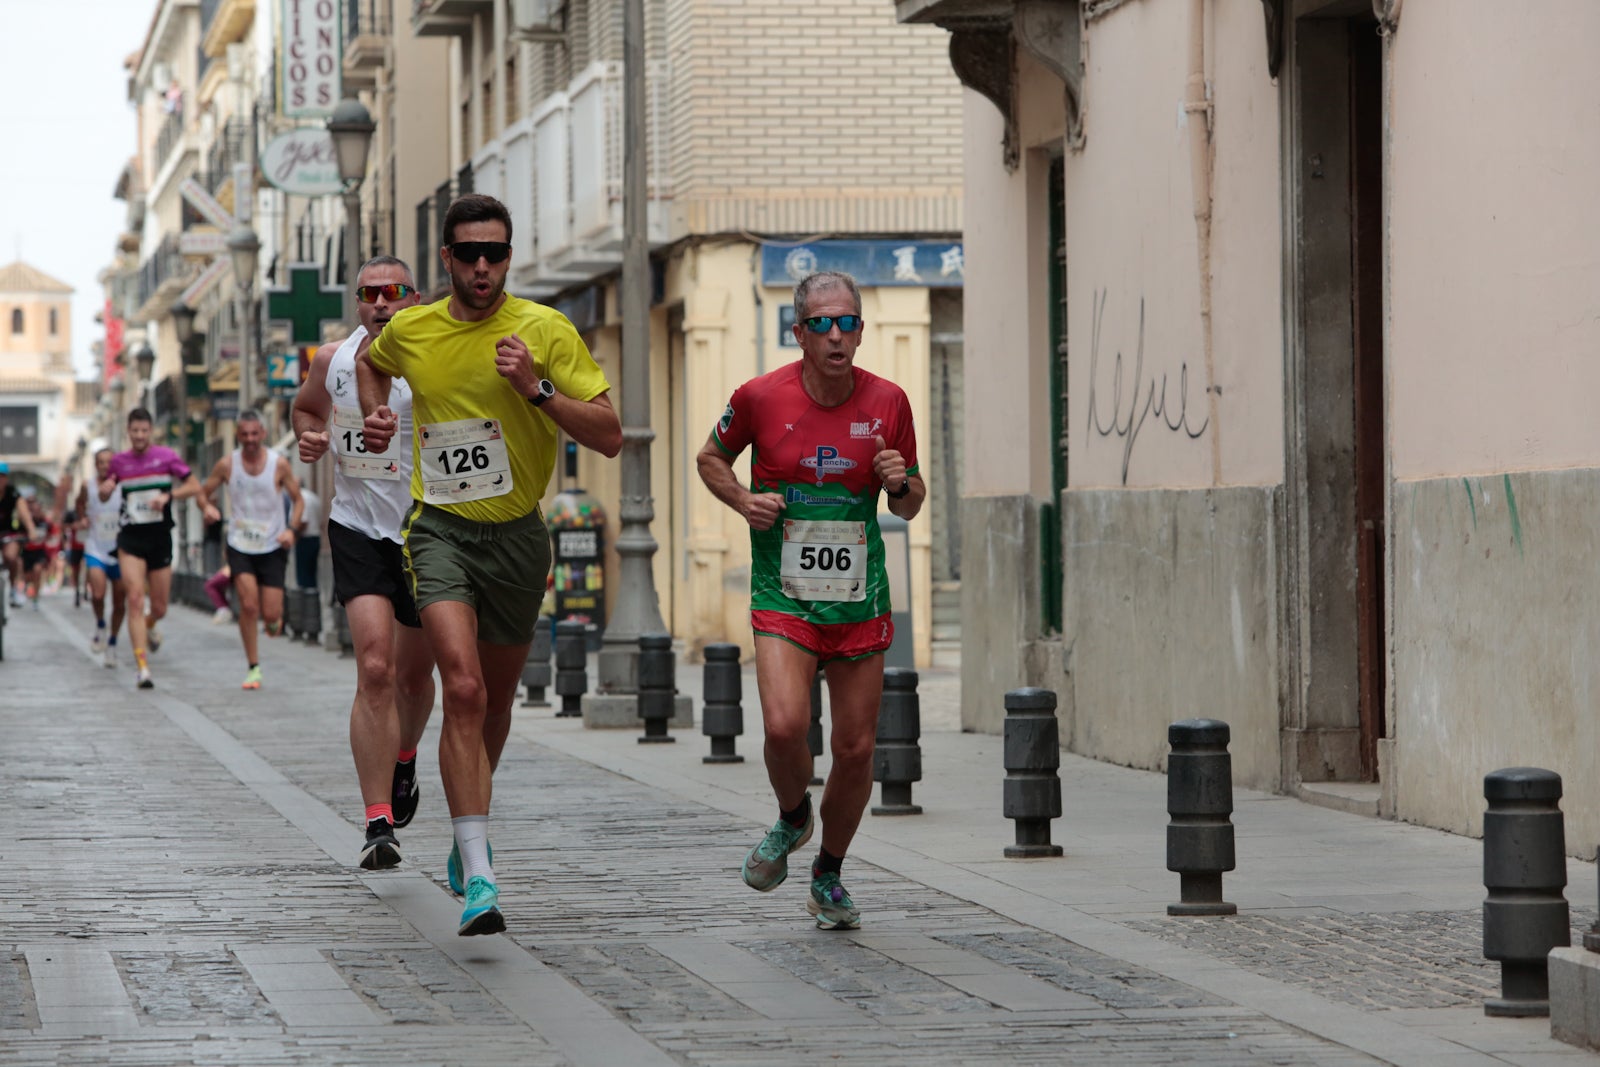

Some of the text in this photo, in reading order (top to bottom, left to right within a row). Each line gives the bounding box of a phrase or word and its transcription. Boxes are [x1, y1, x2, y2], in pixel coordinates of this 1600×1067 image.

[342, 430, 368, 454] 13
[438, 445, 489, 475] 126
[800, 547, 851, 571] 506
